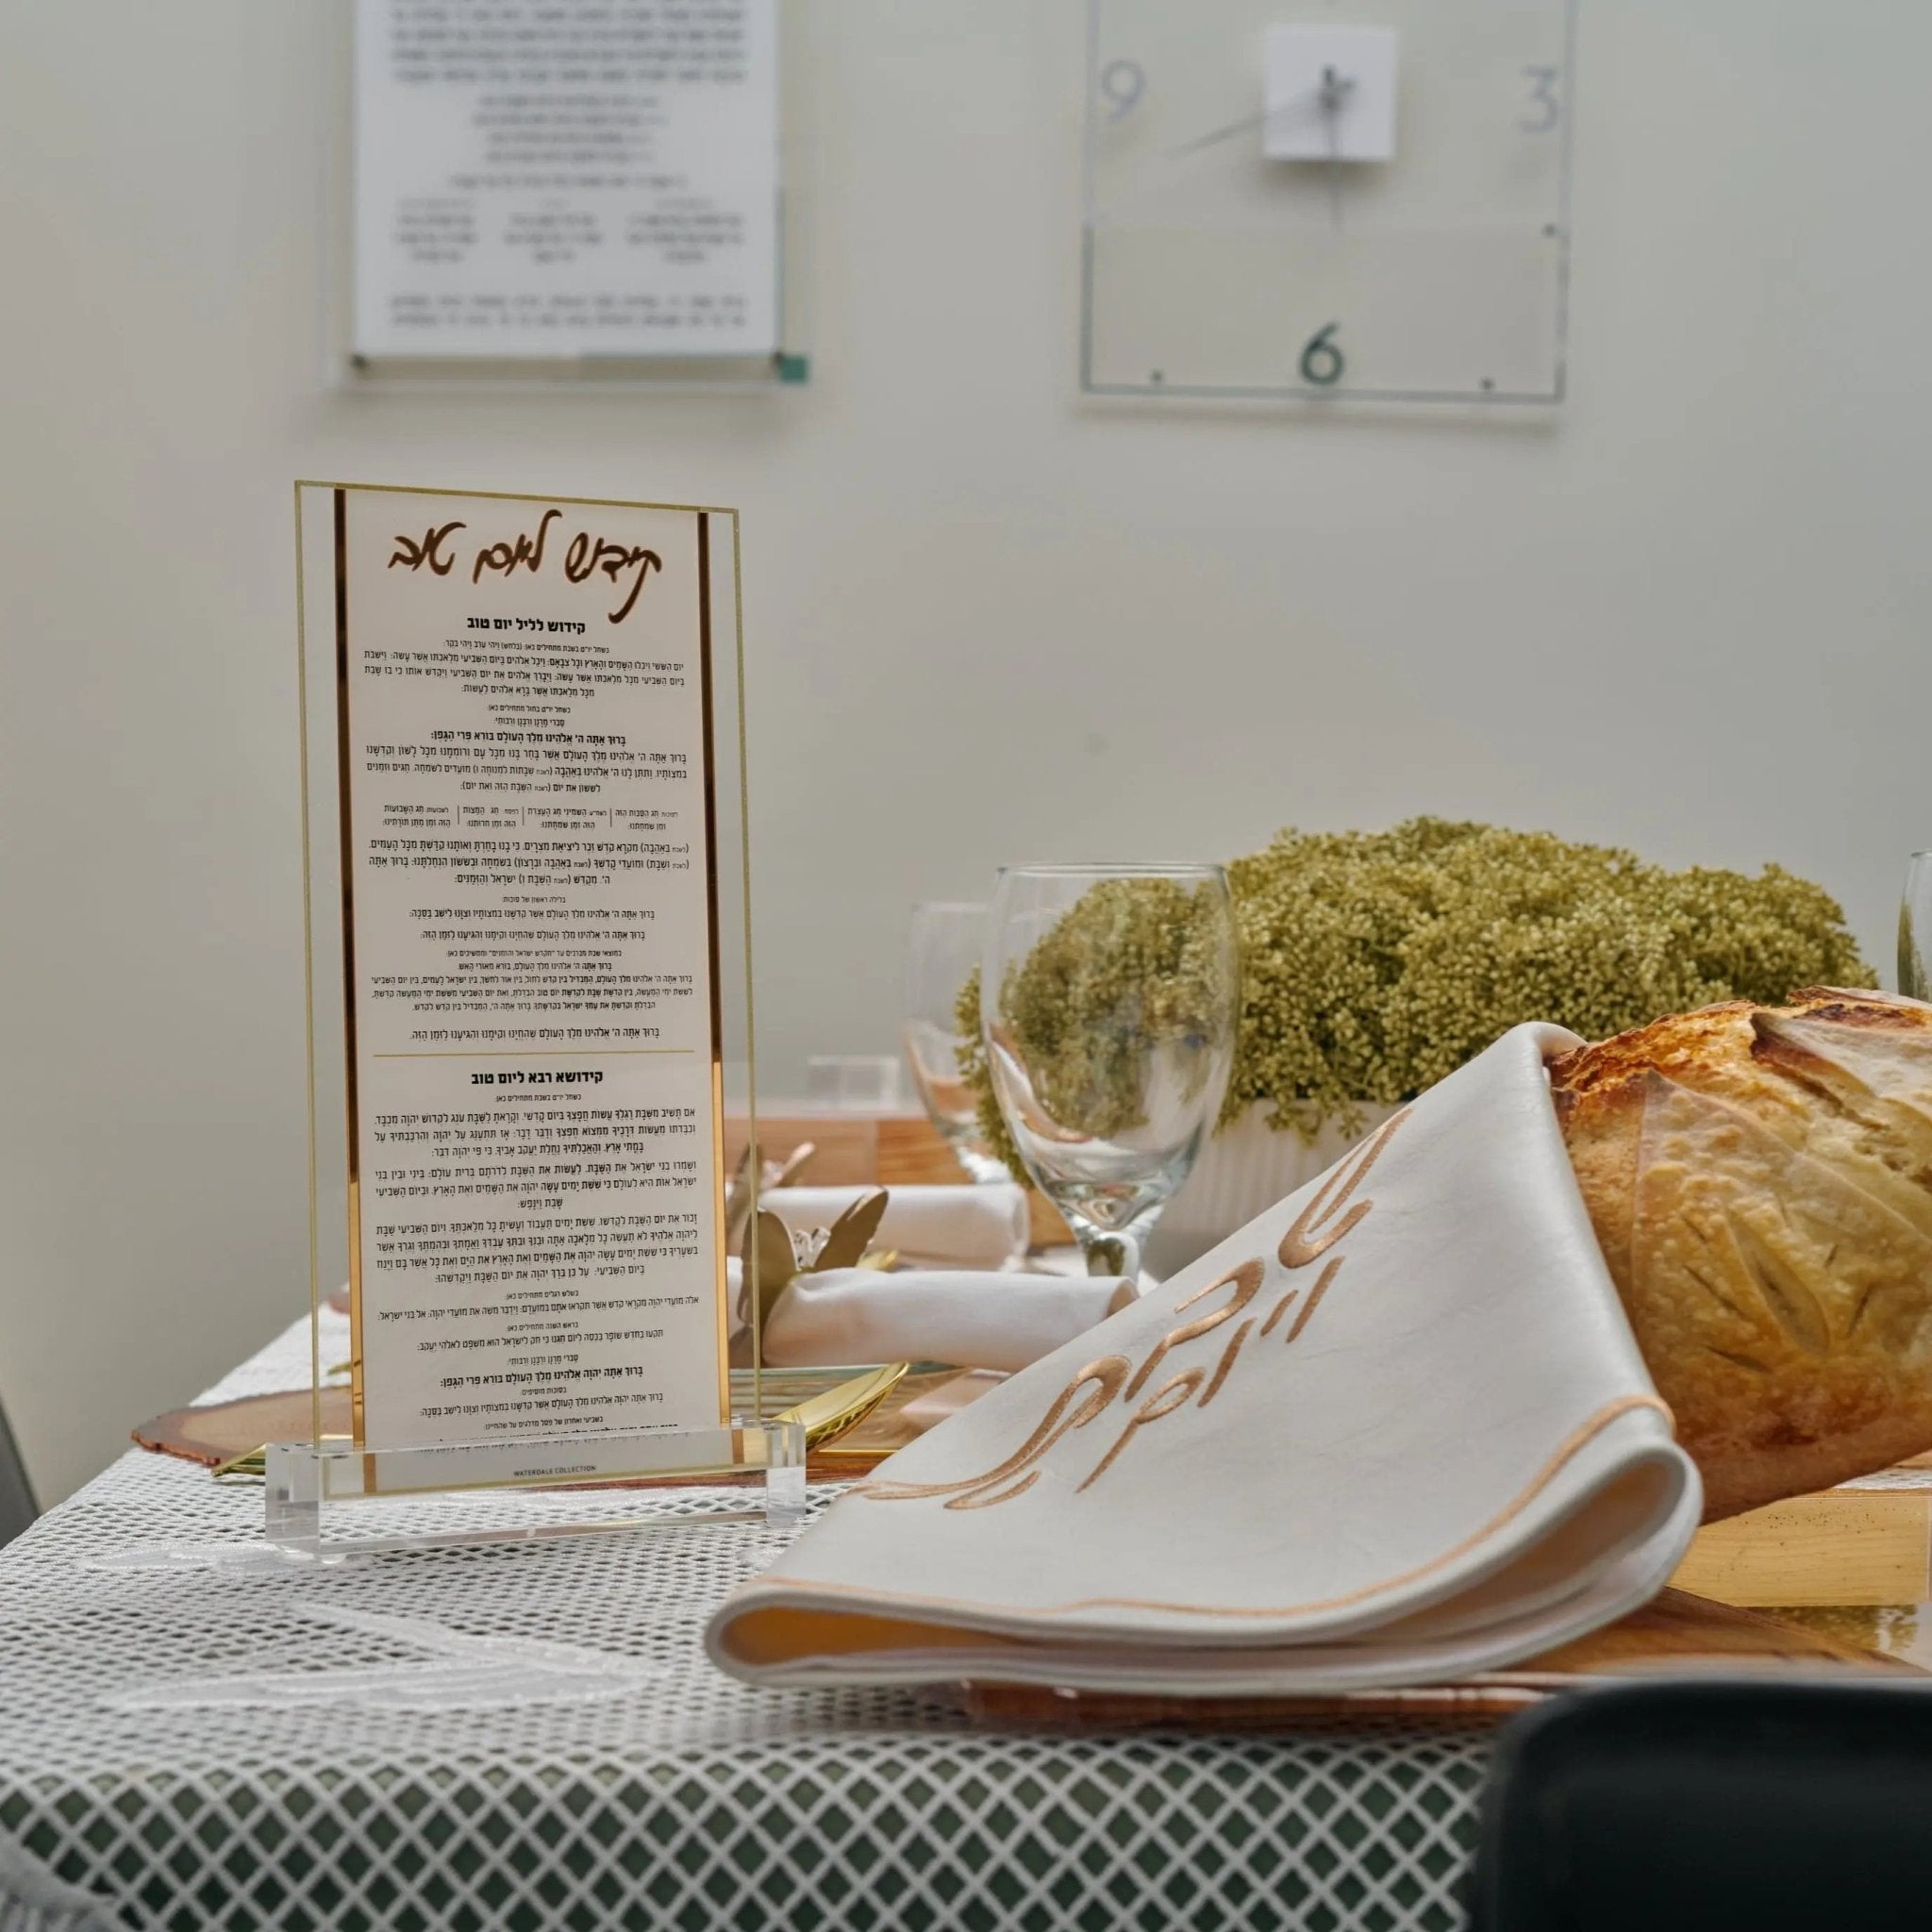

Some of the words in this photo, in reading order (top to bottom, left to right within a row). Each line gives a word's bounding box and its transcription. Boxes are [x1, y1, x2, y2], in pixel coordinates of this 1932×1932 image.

[1101, 58, 1145, 123] 9
[1520, 65, 1560, 134] 3
[1299, 321, 1343, 386] 6
[387, 521, 467, 576] טוב
[466, 616, 491, 629] טוב
[492, 618, 512, 630] יום
[515, 617, 544, 632] לליל
[546, 620, 586, 635] קידוש
[470, 1073, 494, 1085] טוב
[496, 1070, 525, 1084] ליום
[527, 1072, 553, 1083] רבא
[555, 1071, 604, 1084] קידושא
[513, 1468, 553, 1476] WATERDALE
[555, 1464, 595, 1474] COLLECTION
